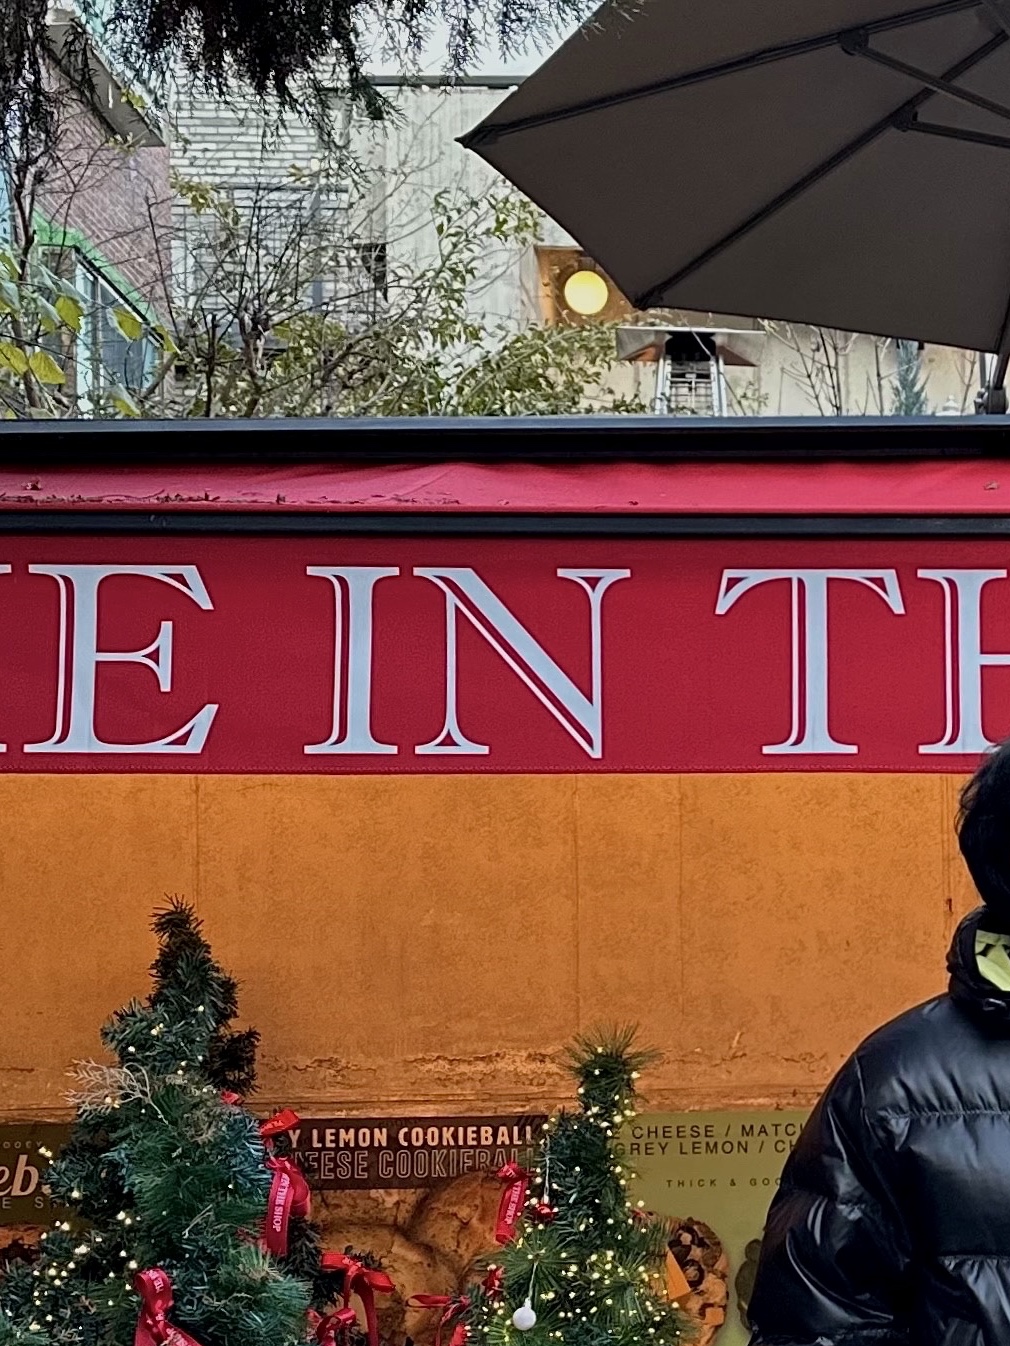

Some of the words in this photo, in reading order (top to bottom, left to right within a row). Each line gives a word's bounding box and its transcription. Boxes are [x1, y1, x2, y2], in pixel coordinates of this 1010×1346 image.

[0, 565, 219, 755] E
[304, 565, 632, 759] IN
[312, 1128, 388, 1148] LEMON
[398, 1125, 533, 1147] COOKIEBALL
[631, 1124, 715, 1140] CHEESE
[679, 1141, 749, 1155] LEMON
[666, 1179, 717, 1189] THICK
[272, 1206, 284, 1233] SHOP
